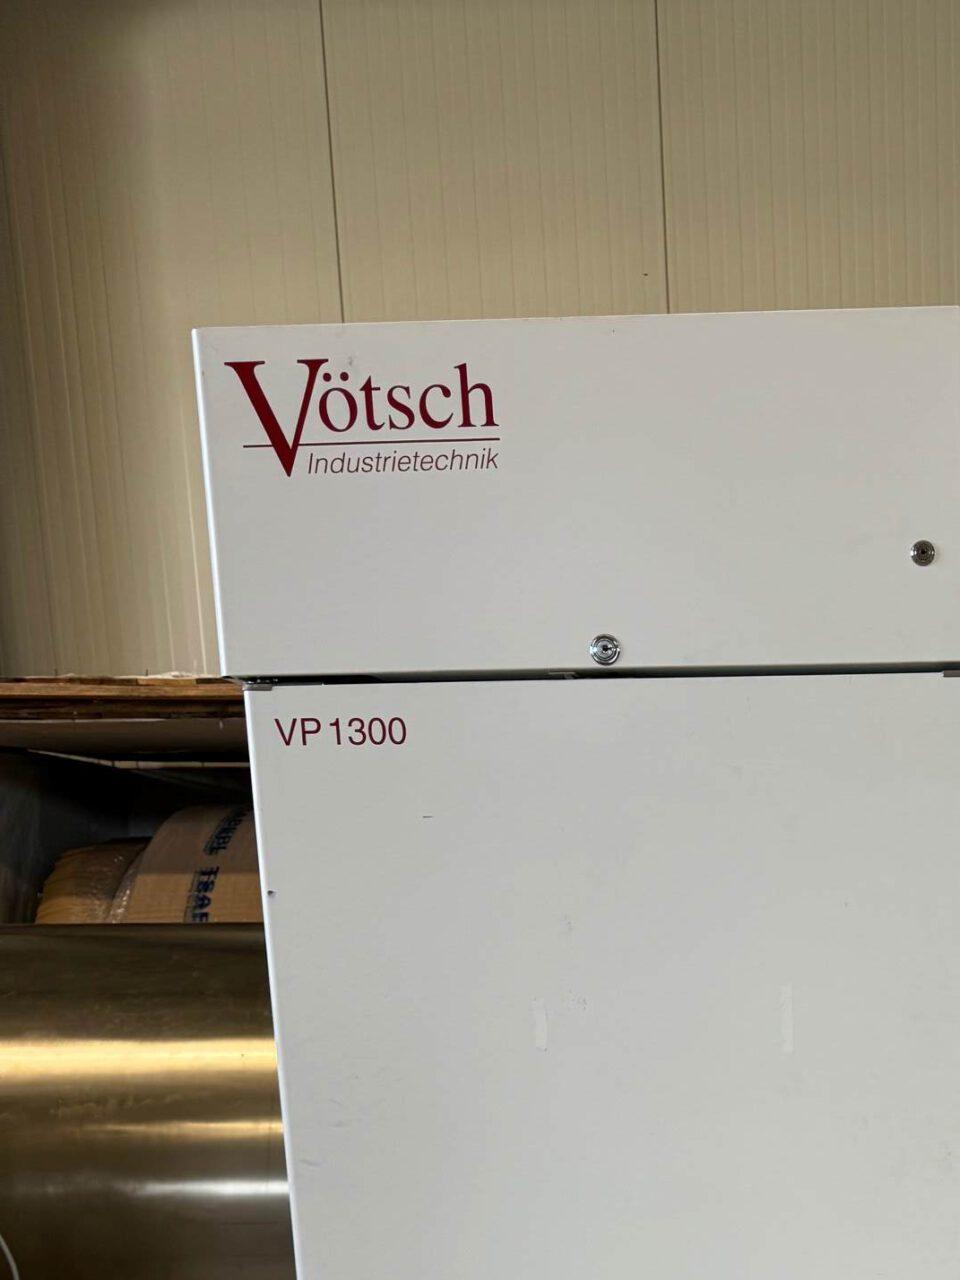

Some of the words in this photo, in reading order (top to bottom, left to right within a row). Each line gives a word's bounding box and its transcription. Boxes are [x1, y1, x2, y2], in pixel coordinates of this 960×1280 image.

[224, 358, 500, 478] Vötsch
[307, 447, 500, 476] Industrietechnik
[274, 718, 322, 747] VP
[329, 717, 407, 746] 1300
